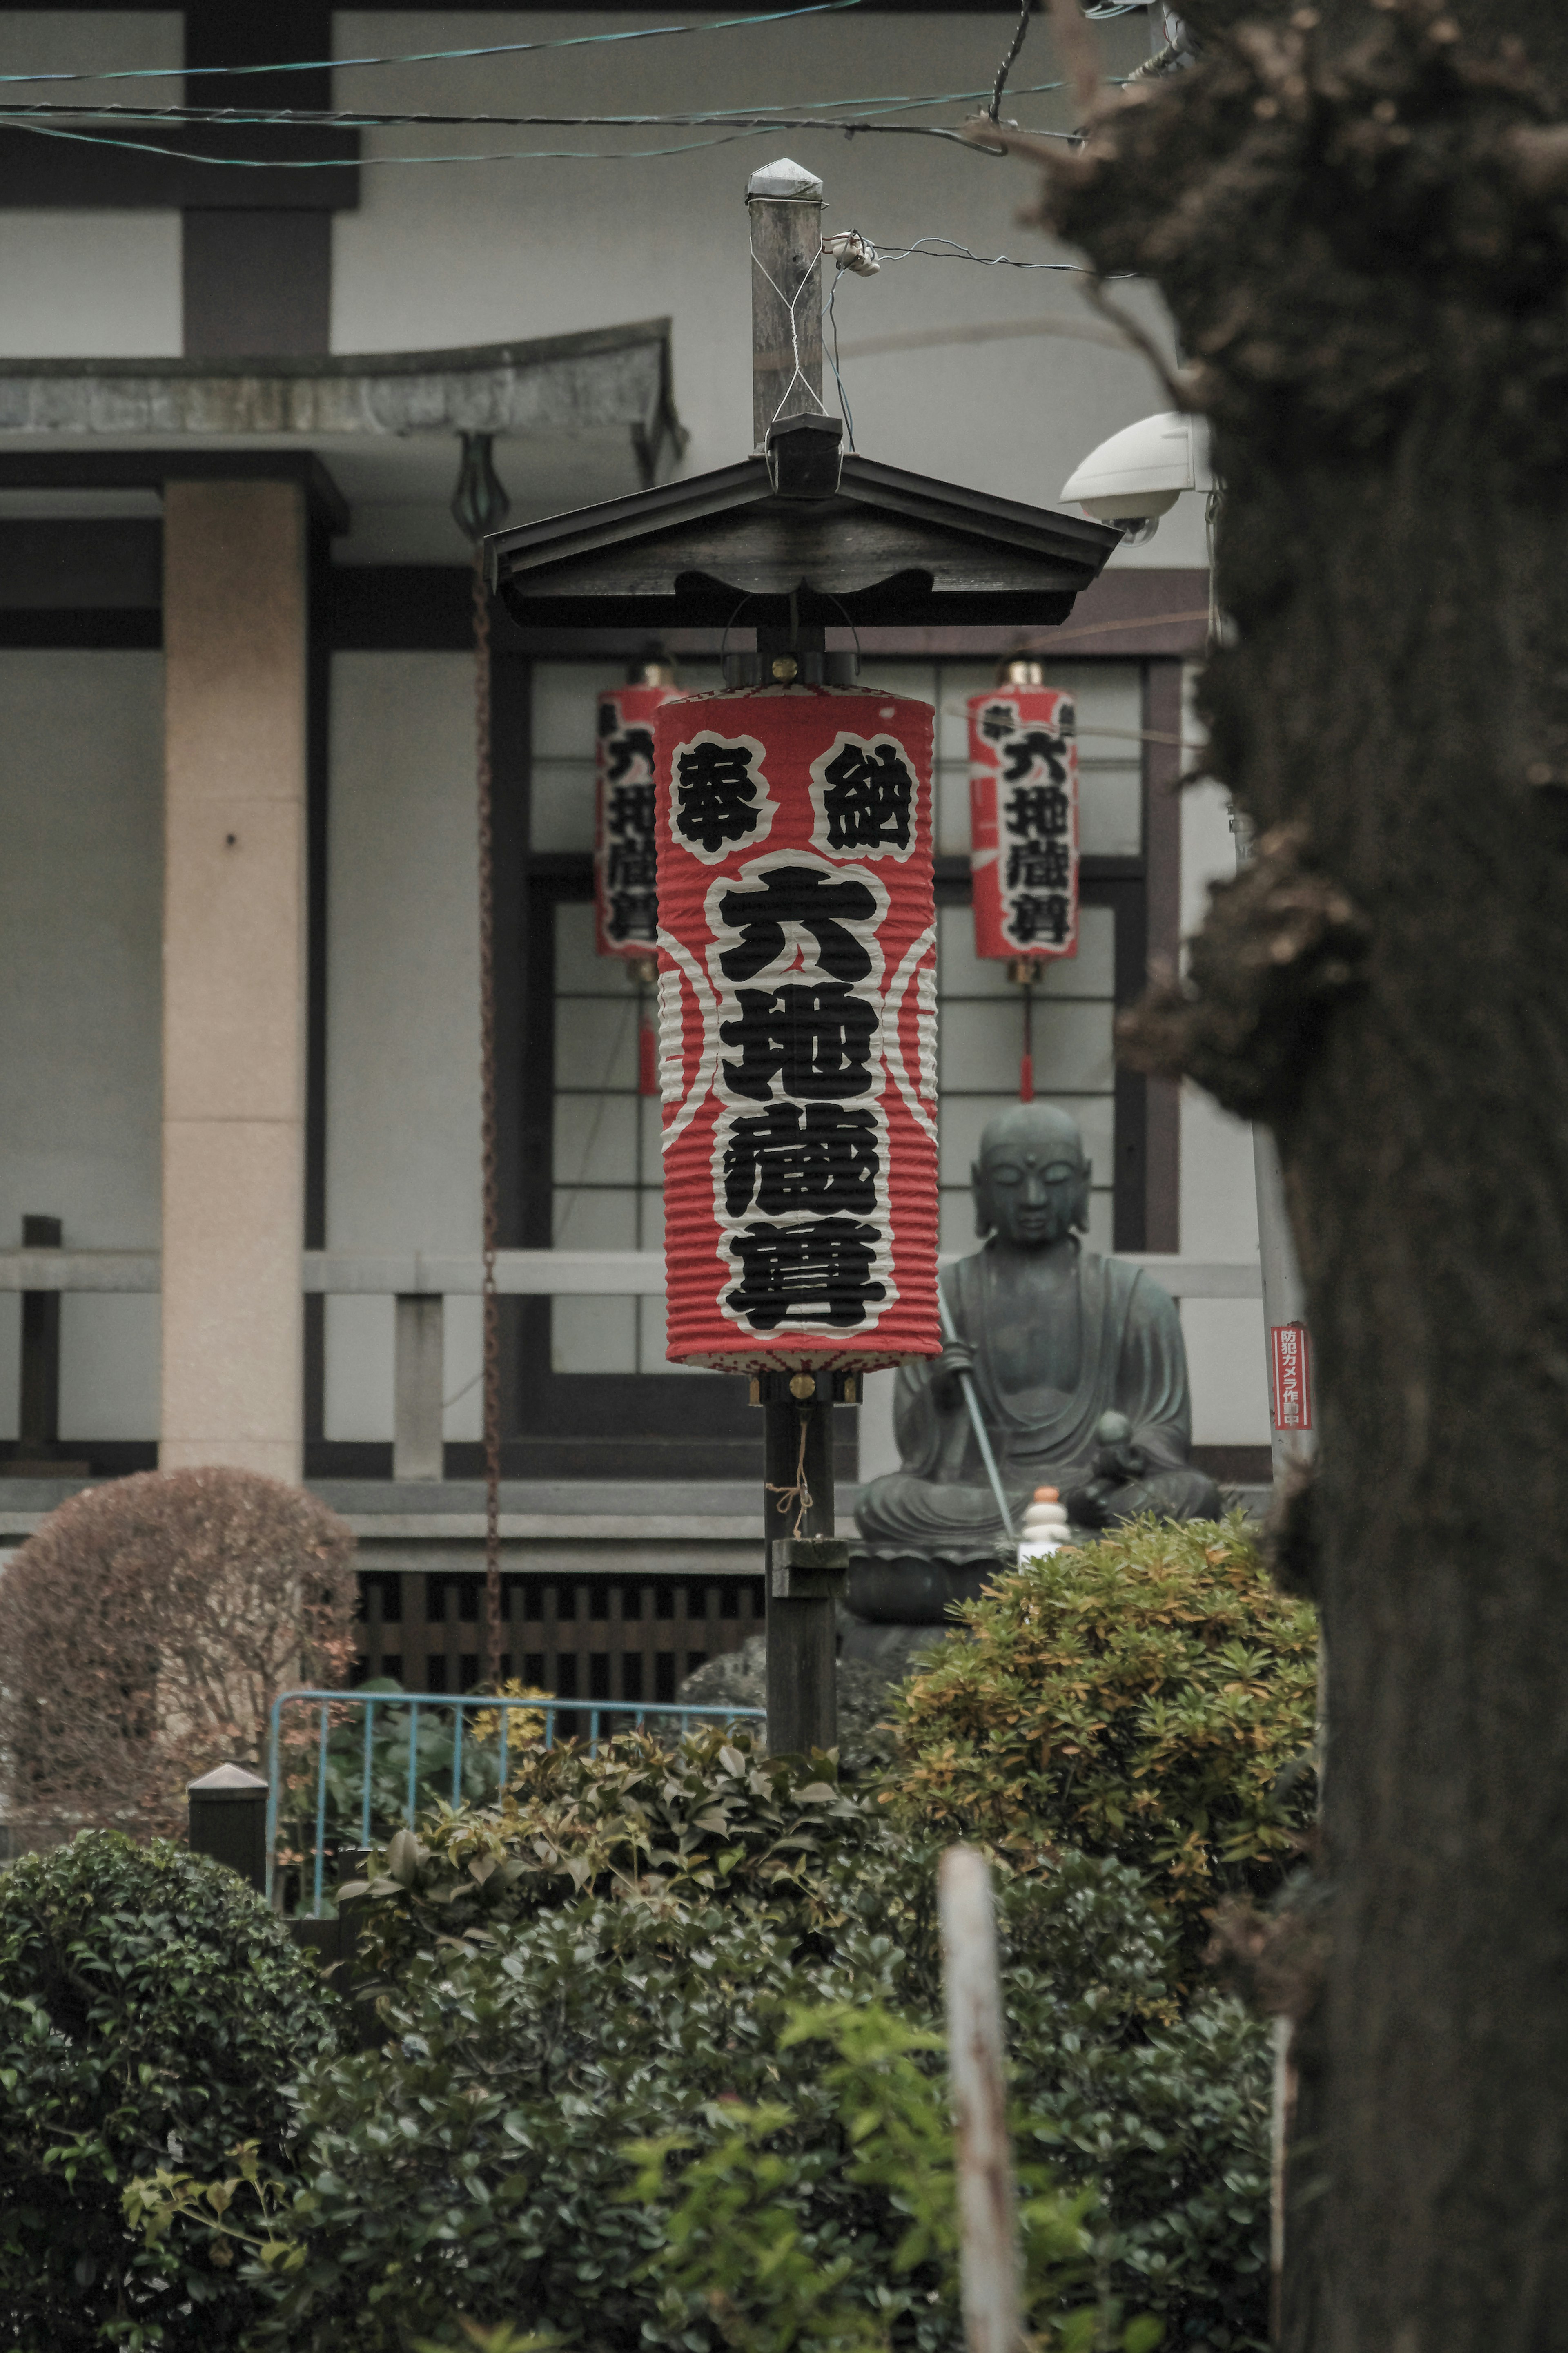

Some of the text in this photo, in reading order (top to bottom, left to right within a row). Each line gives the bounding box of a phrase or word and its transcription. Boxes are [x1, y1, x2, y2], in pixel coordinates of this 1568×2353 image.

[719, 865, 887, 1330] 六地蔵尊
[1281, 1330, 1299, 1427] 防犯カメラ作動中
